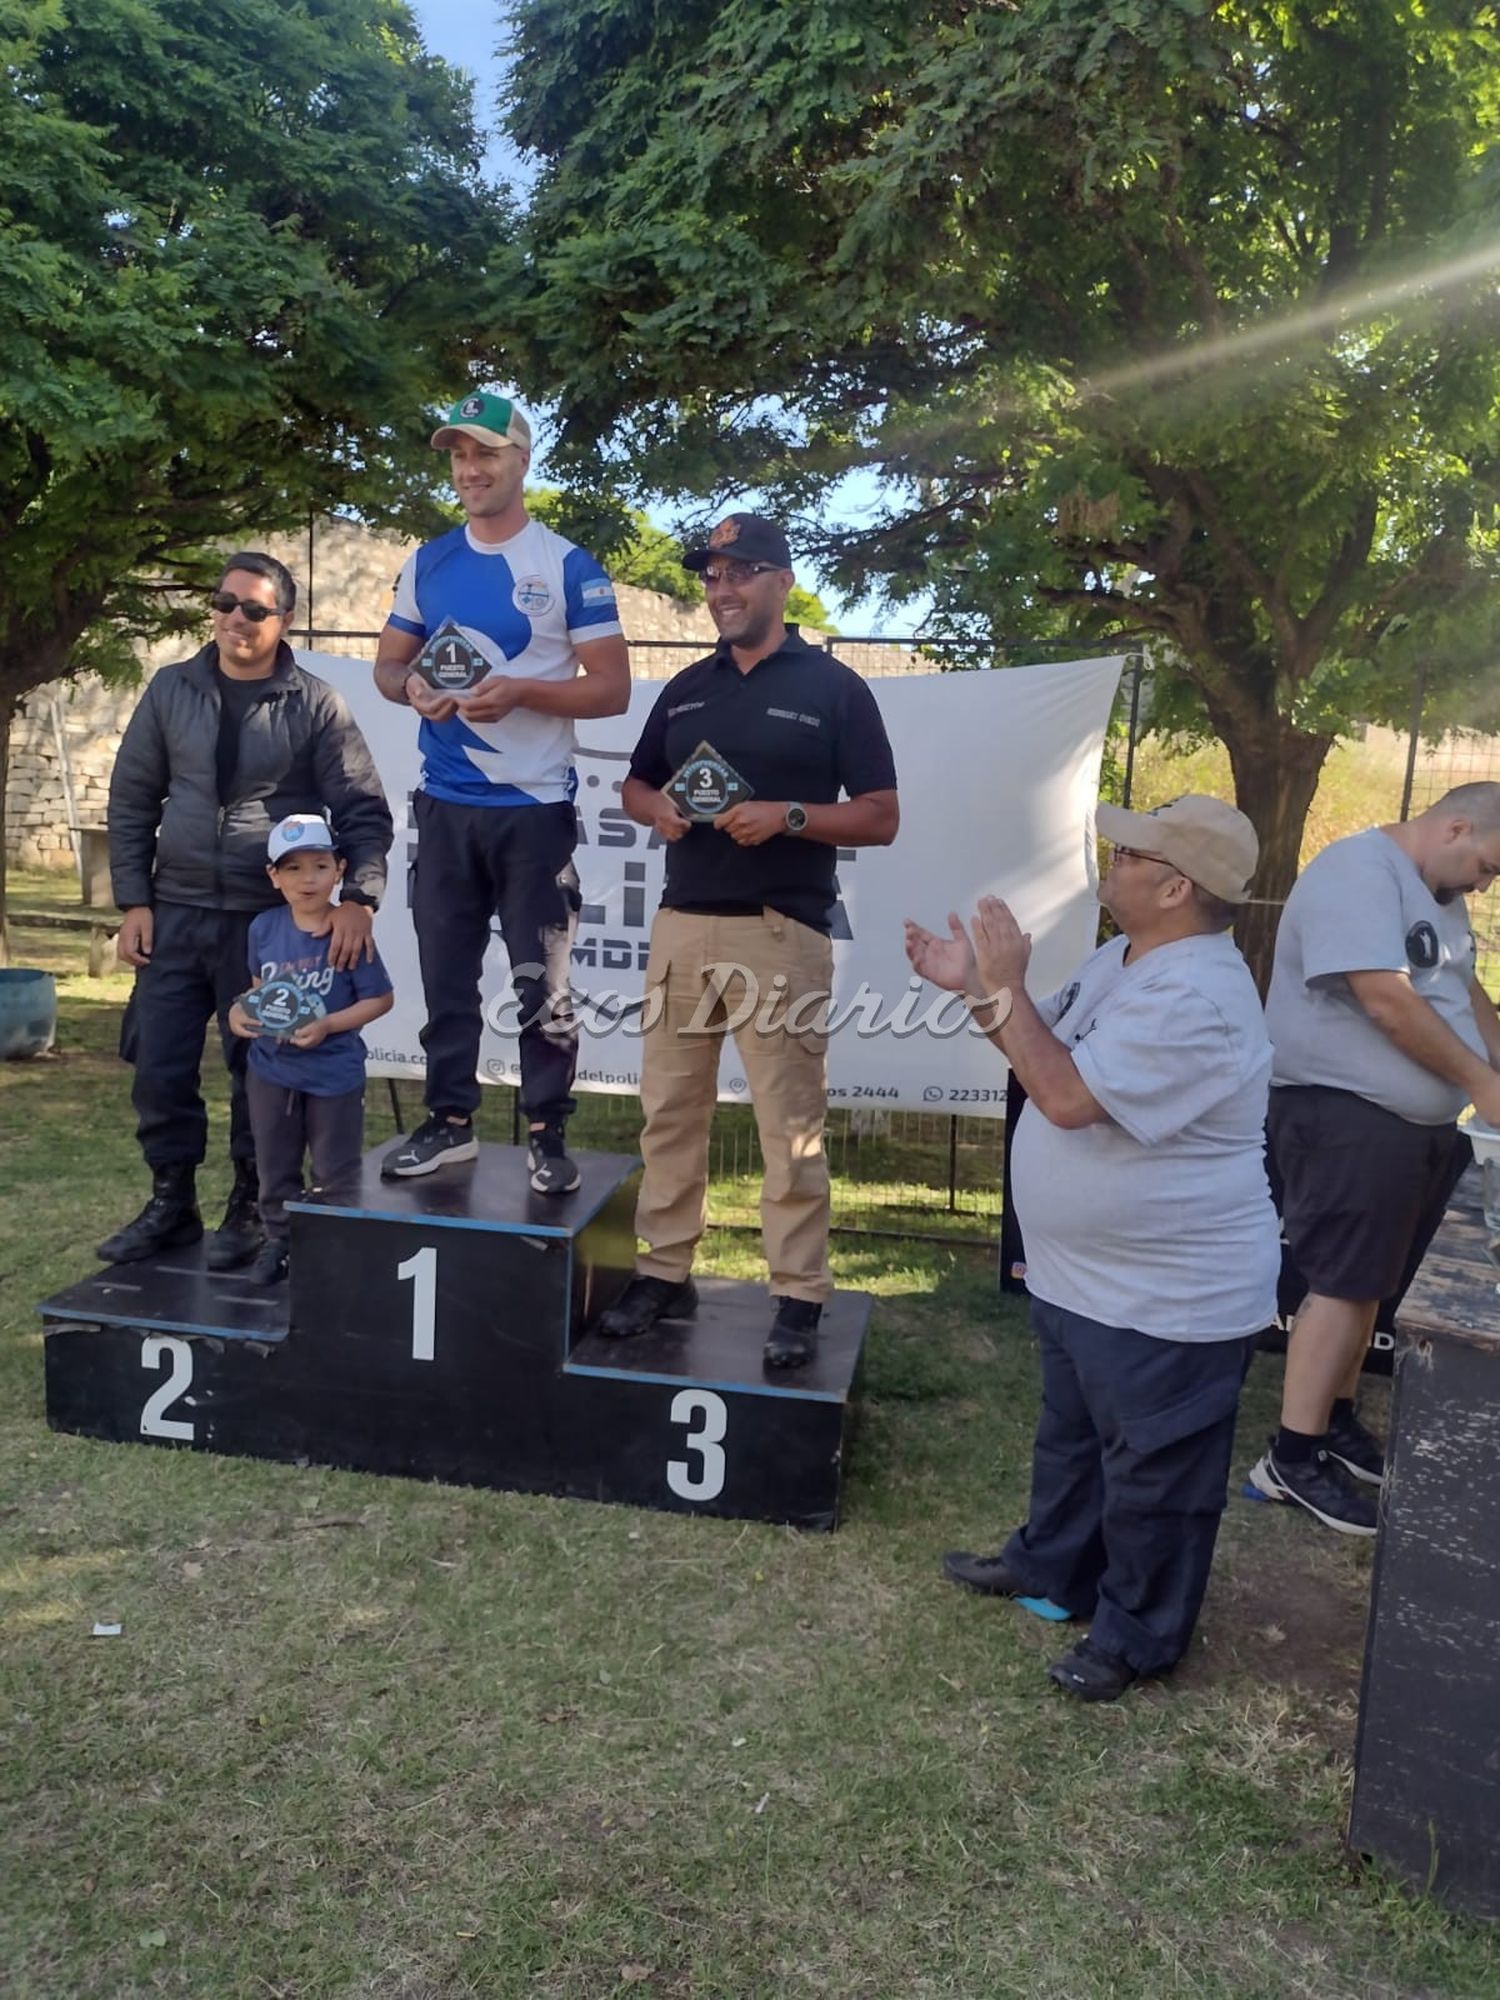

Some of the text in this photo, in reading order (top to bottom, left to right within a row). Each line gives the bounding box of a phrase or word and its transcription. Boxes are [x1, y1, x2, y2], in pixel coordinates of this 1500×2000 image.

[446, 642, 457, 664] 1
[700, 767, 713, 788] 3
[272, 987, 290, 1007] 2
[577, 1069, 640, 1086] delpoli
[826, 1087, 847, 1097] os
[852, 1085, 899, 1099] 2444
[949, 1088, 1008, 1103] 223312
[397, 1246, 437, 1361] 1
[140, 1335, 194, 1441] 2
[666, 1388, 728, 1502] 3
